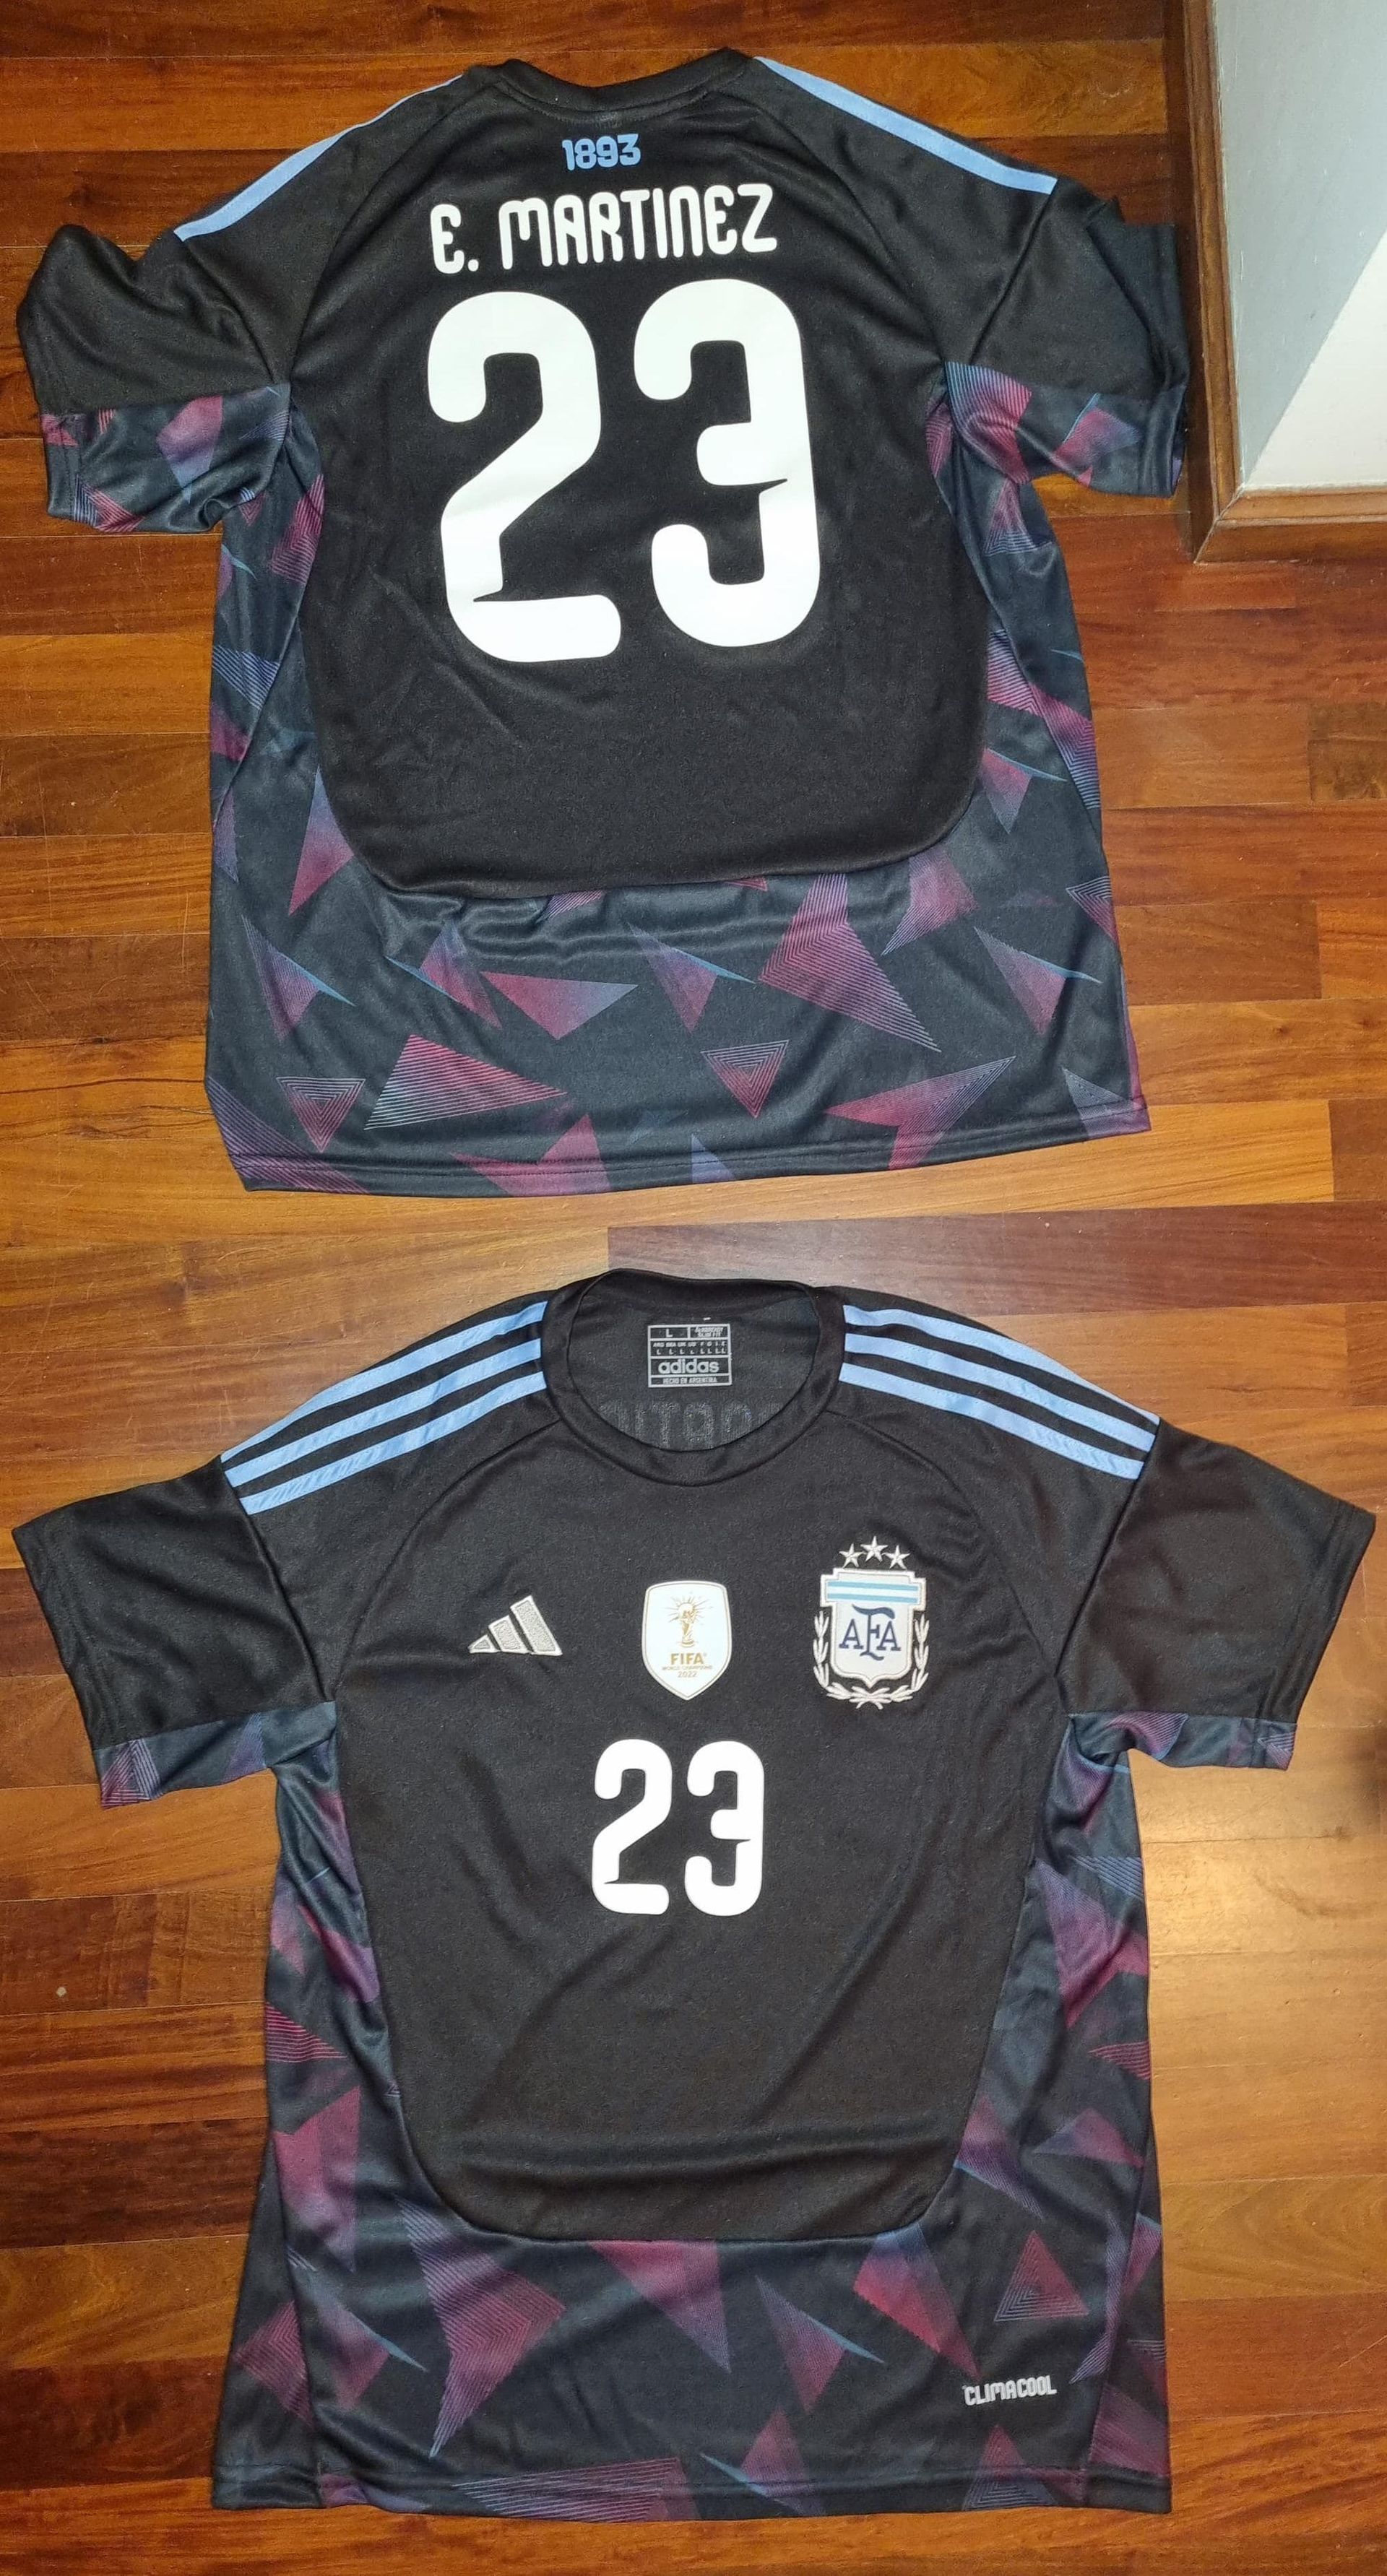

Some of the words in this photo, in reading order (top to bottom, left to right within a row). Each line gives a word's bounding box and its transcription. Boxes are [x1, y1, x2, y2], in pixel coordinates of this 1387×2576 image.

[562, 134, 641, 171] 1893
[431, 203, 479, 274] E.
[498, 183, 777, 269] MARTINEZ
[428, 278, 821, 662] 23
[665, 1328, 673, 1337] L
[658, 1358, 720, 1374] adidas
[839, 1604, 901, 1661] AFA
[670, 1653, 704, 1665] FIFA
[592, 1739, 764, 1916] 23
[964, 2375, 1057, 2406] CLIMACOOL
